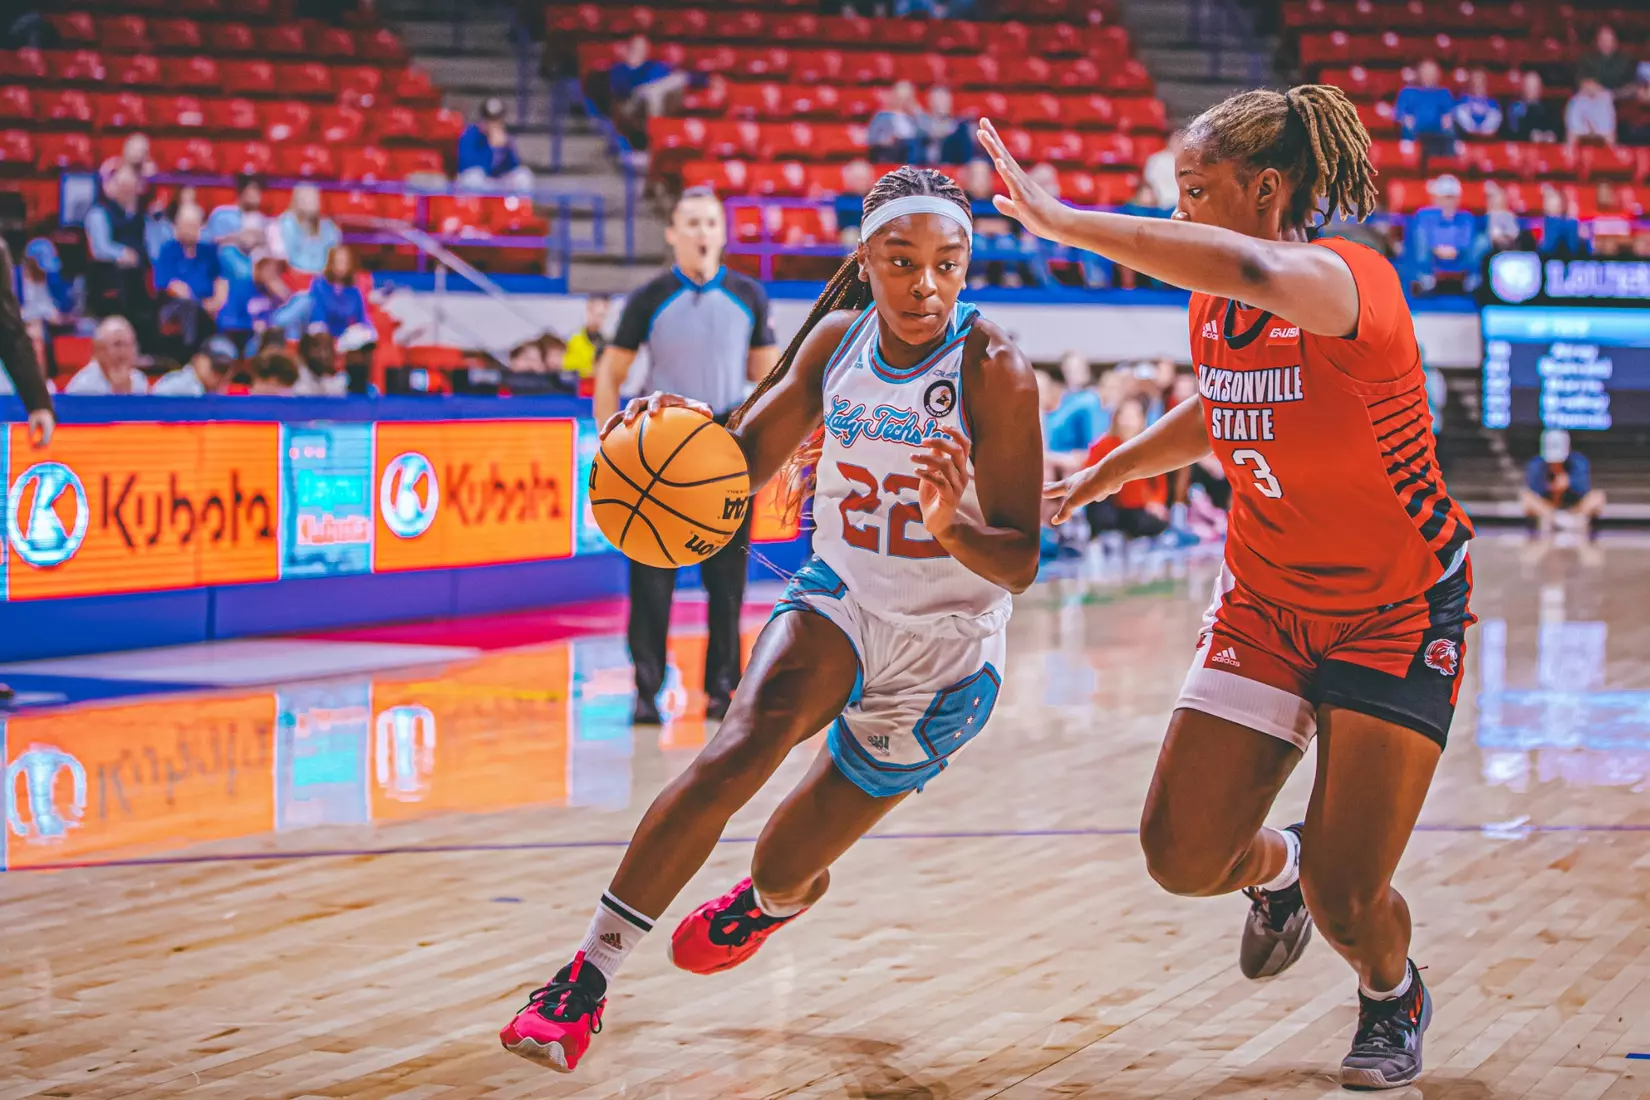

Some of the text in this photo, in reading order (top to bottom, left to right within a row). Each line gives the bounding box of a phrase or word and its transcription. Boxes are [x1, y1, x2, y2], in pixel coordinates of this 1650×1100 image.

[825, 395, 866, 448] Lady
[1211, 406, 1275, 441] STATE
[445, 463, 562, 524] Kubota
[1232, 448, 1283, 498] 3
[101, 469, 271, 549] Kubota
[836, 461, 951, 560] 22
[1212, 656, 1240, 667] adidas
